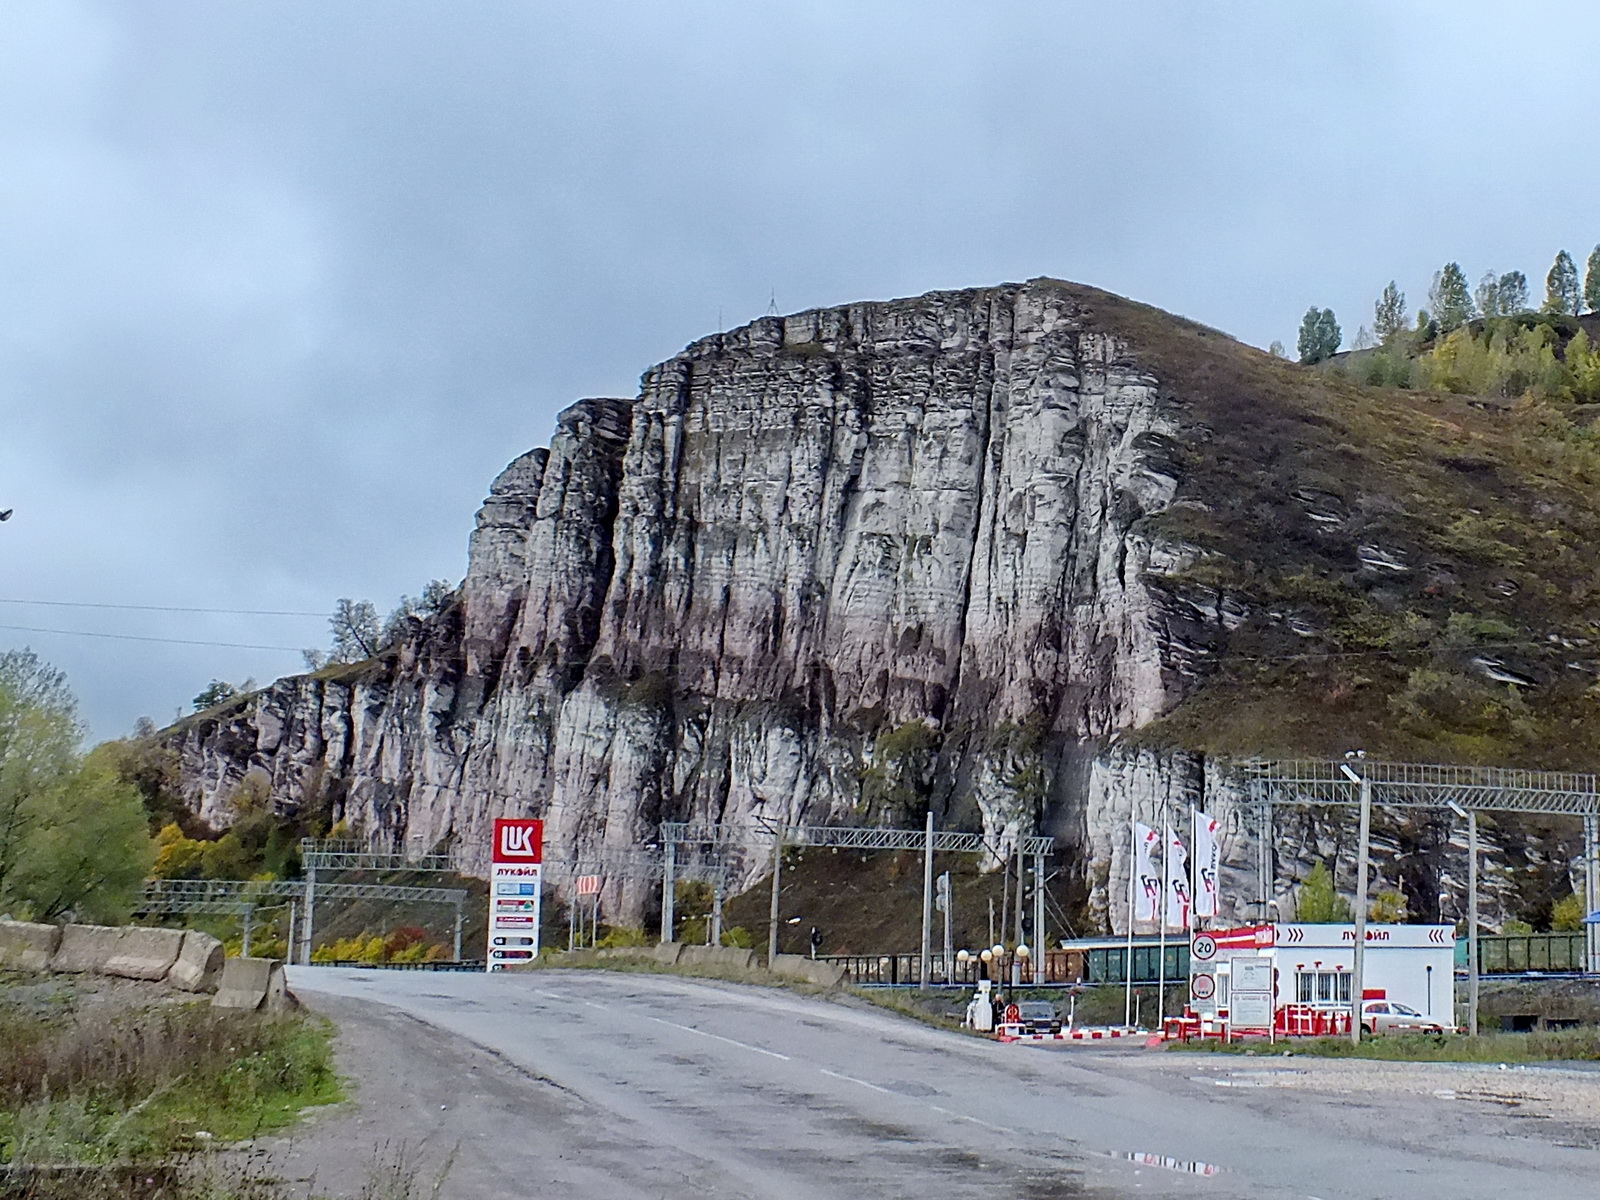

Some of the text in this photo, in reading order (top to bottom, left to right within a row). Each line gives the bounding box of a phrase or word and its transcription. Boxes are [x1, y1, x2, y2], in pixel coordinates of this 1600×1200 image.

[497, 866, 538, 876] ЛУКОЙЛ
[1342, 929, 1390, 941] ЛУОЙЛ
[1197, 942, 1212, 953] 20
